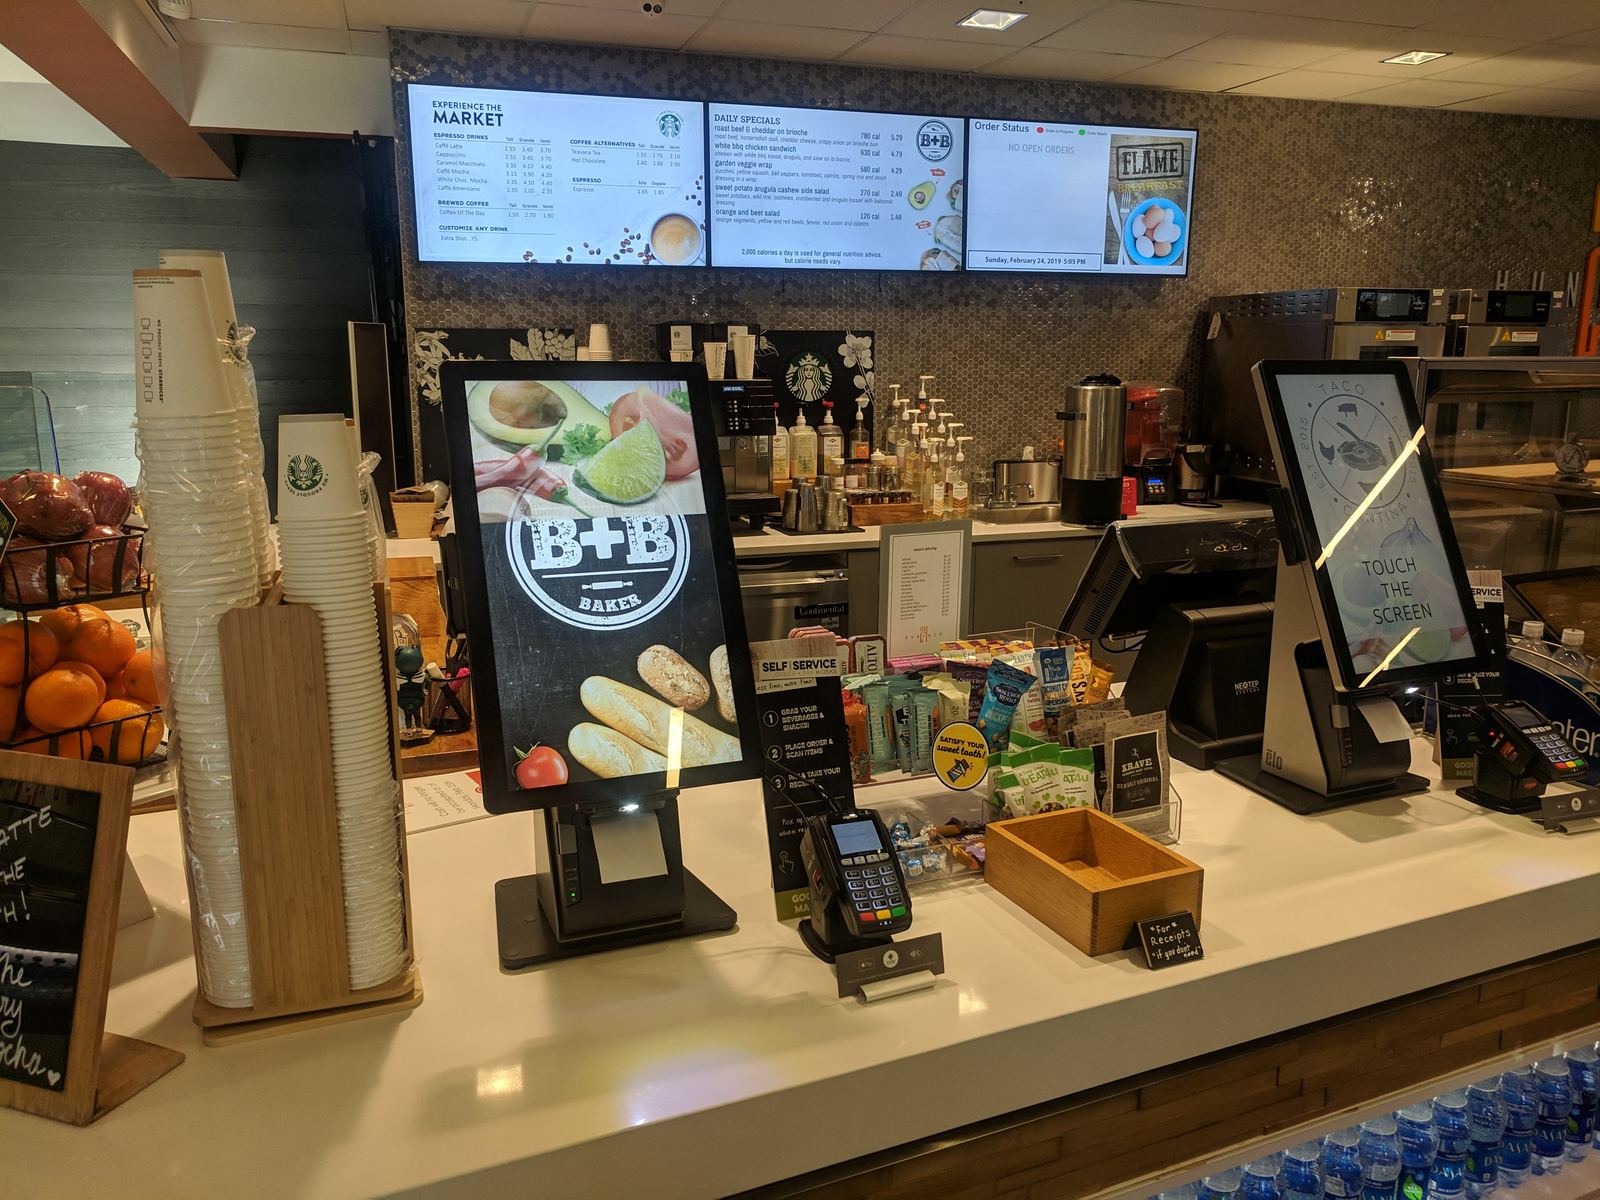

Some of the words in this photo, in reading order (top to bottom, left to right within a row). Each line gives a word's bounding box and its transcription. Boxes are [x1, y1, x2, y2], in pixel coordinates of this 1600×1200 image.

[433, 101, 484, 110] EXPERIENCE
[433, 110, 503, 127] MARKET
[714, 114, 738, 122] DAILY
[740, 116, 780, 125] SPECIALS
[975, 122, 999, 131] Order
[1002, 123, 1029, 133] Status
[920, 134, 950, 148] B+B
[1022, 144, 1042, 152] OPEN
[1045, 146, 1074, 154] ORDERS
[1122, 149, 1179, 176] FLAME
[985, 256, 1009, 265] Sunday,
[1010, 257, 1036, 265] February
[1319, 380, 1364, 394] TACO
[1343, 503, 1408, 524] CNTINA
[525, 514, 676, 570] B+B
[1362, 557, 1416, 576] TOUCH
[1381, 581, 1412, 598] THE
[1472, 588, 1501, 596] ERVICE
[578, 594, 642, 612] BAKER
[1373, 603, 1432, 625] SCREEN
[762, 662, 787, 672] SELF
[793, 659, 836, 670] SERVICE
[867, 644, 877, 675] ALTO
[781, 707, 799, 715] GRAB
[768, 715, 773, 724] 1
[782, 714, 819, 724] BEVERAGES
[785, 742, 805, 751] PLACE
[806, 739, 828, 747] ORDER
[940, 736, 965, 745] SATISFY
[967, 741, 984, 749] YOUR
[772, 749, 778, 758] 2
[786, 750, 804, 758] SCAN
[937, 745, 960, 754] sweet
[961, 747, 986, 759] tooth!
[1122, 758, 1152, 772] KRAVE
[775, 779, 781, 788] 3
[0, 806, 52, 845] ATTE
[0, 856, 26, 886] HE
[1151, 929, 1191, 946] Receipts
